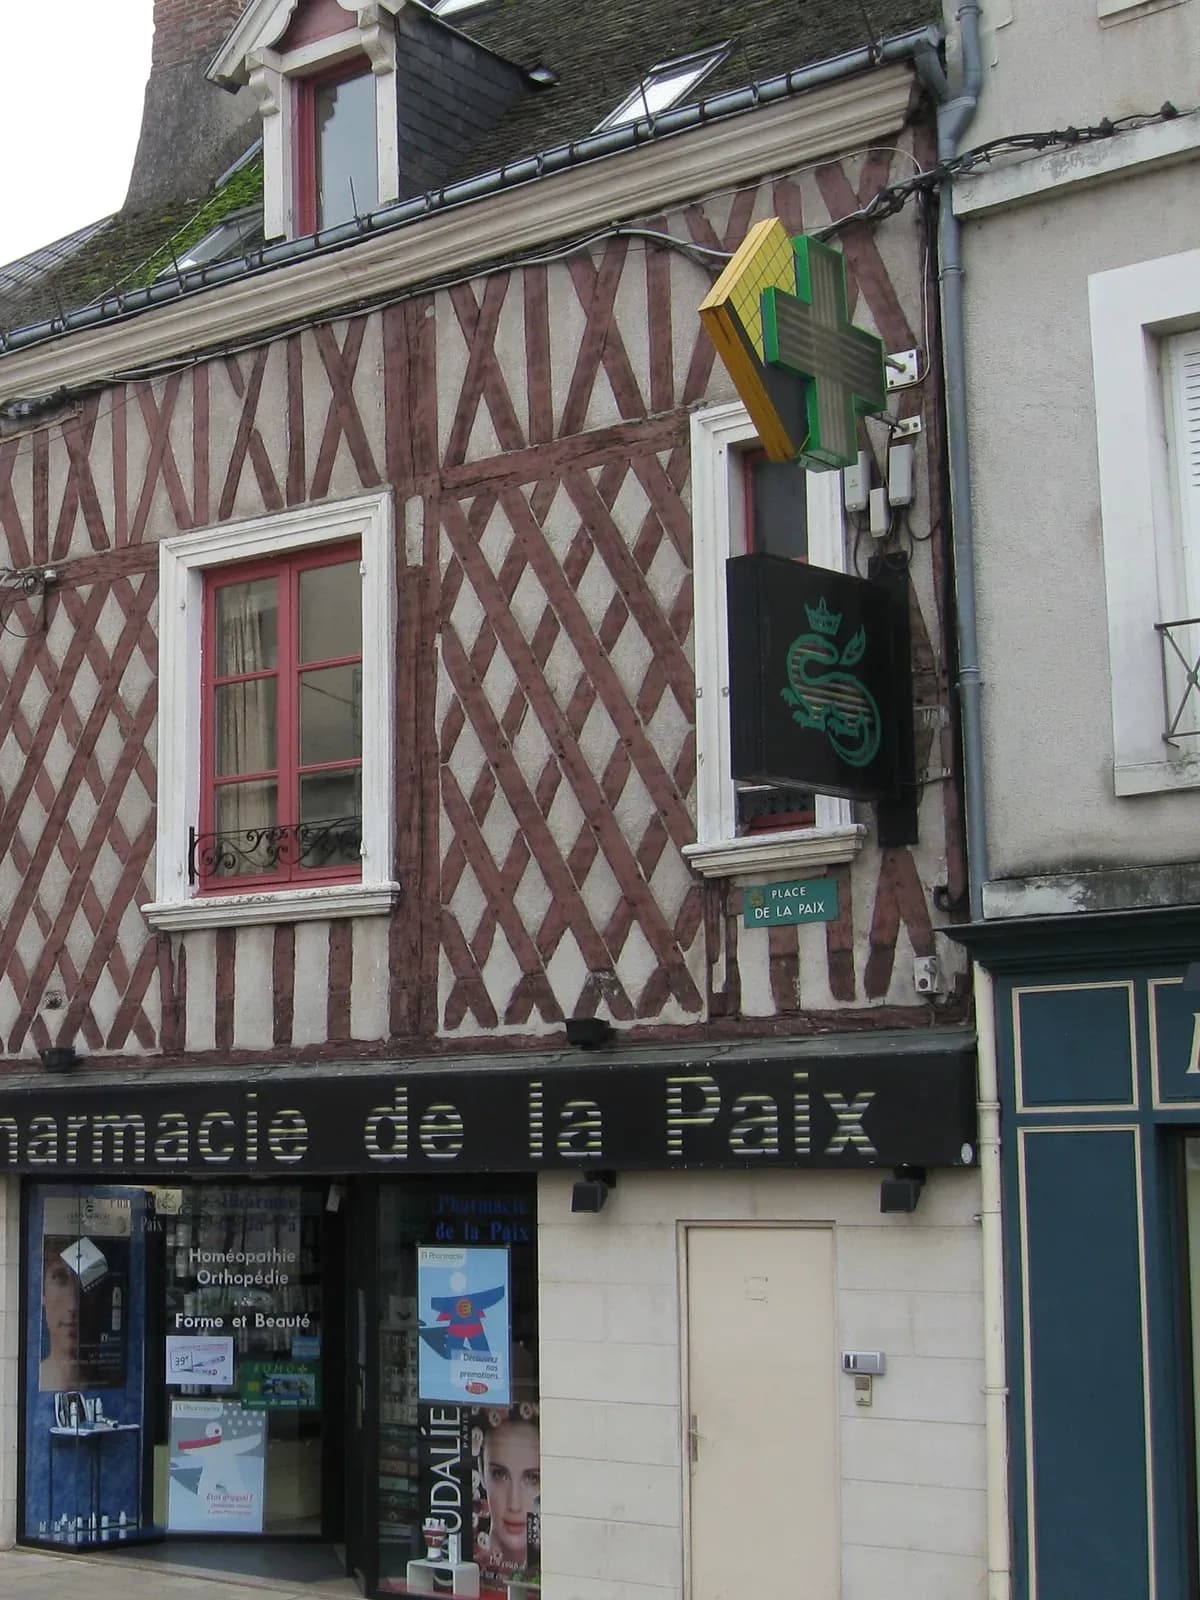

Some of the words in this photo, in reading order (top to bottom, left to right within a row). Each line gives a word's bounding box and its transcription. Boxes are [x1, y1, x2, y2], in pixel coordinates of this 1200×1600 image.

[772, 886, 807, 899] PLACE
[755, 906, 770, 919] DE
[777, 905, 792, 917] LA
[798, 901, 825, 915] PAIX
[364, 1086, 464, 1160] de
[529, 1081, 602, 1159] la
[666, 1072, 878, 1157] Paix
[435, 1221, 453, 1240] de
[464, 1221, 479, 1240] la
[490, 1221, 528, 1241] Paix
[189, 1247, 296, 1266] Homéopathie
[197, 1269, 289, 1287] Orthopédie
[175, 1312, 224, 1329] Forme
[232, 1314, 247, 1328] et
[255, 1313, 311, 1329] Beauté
